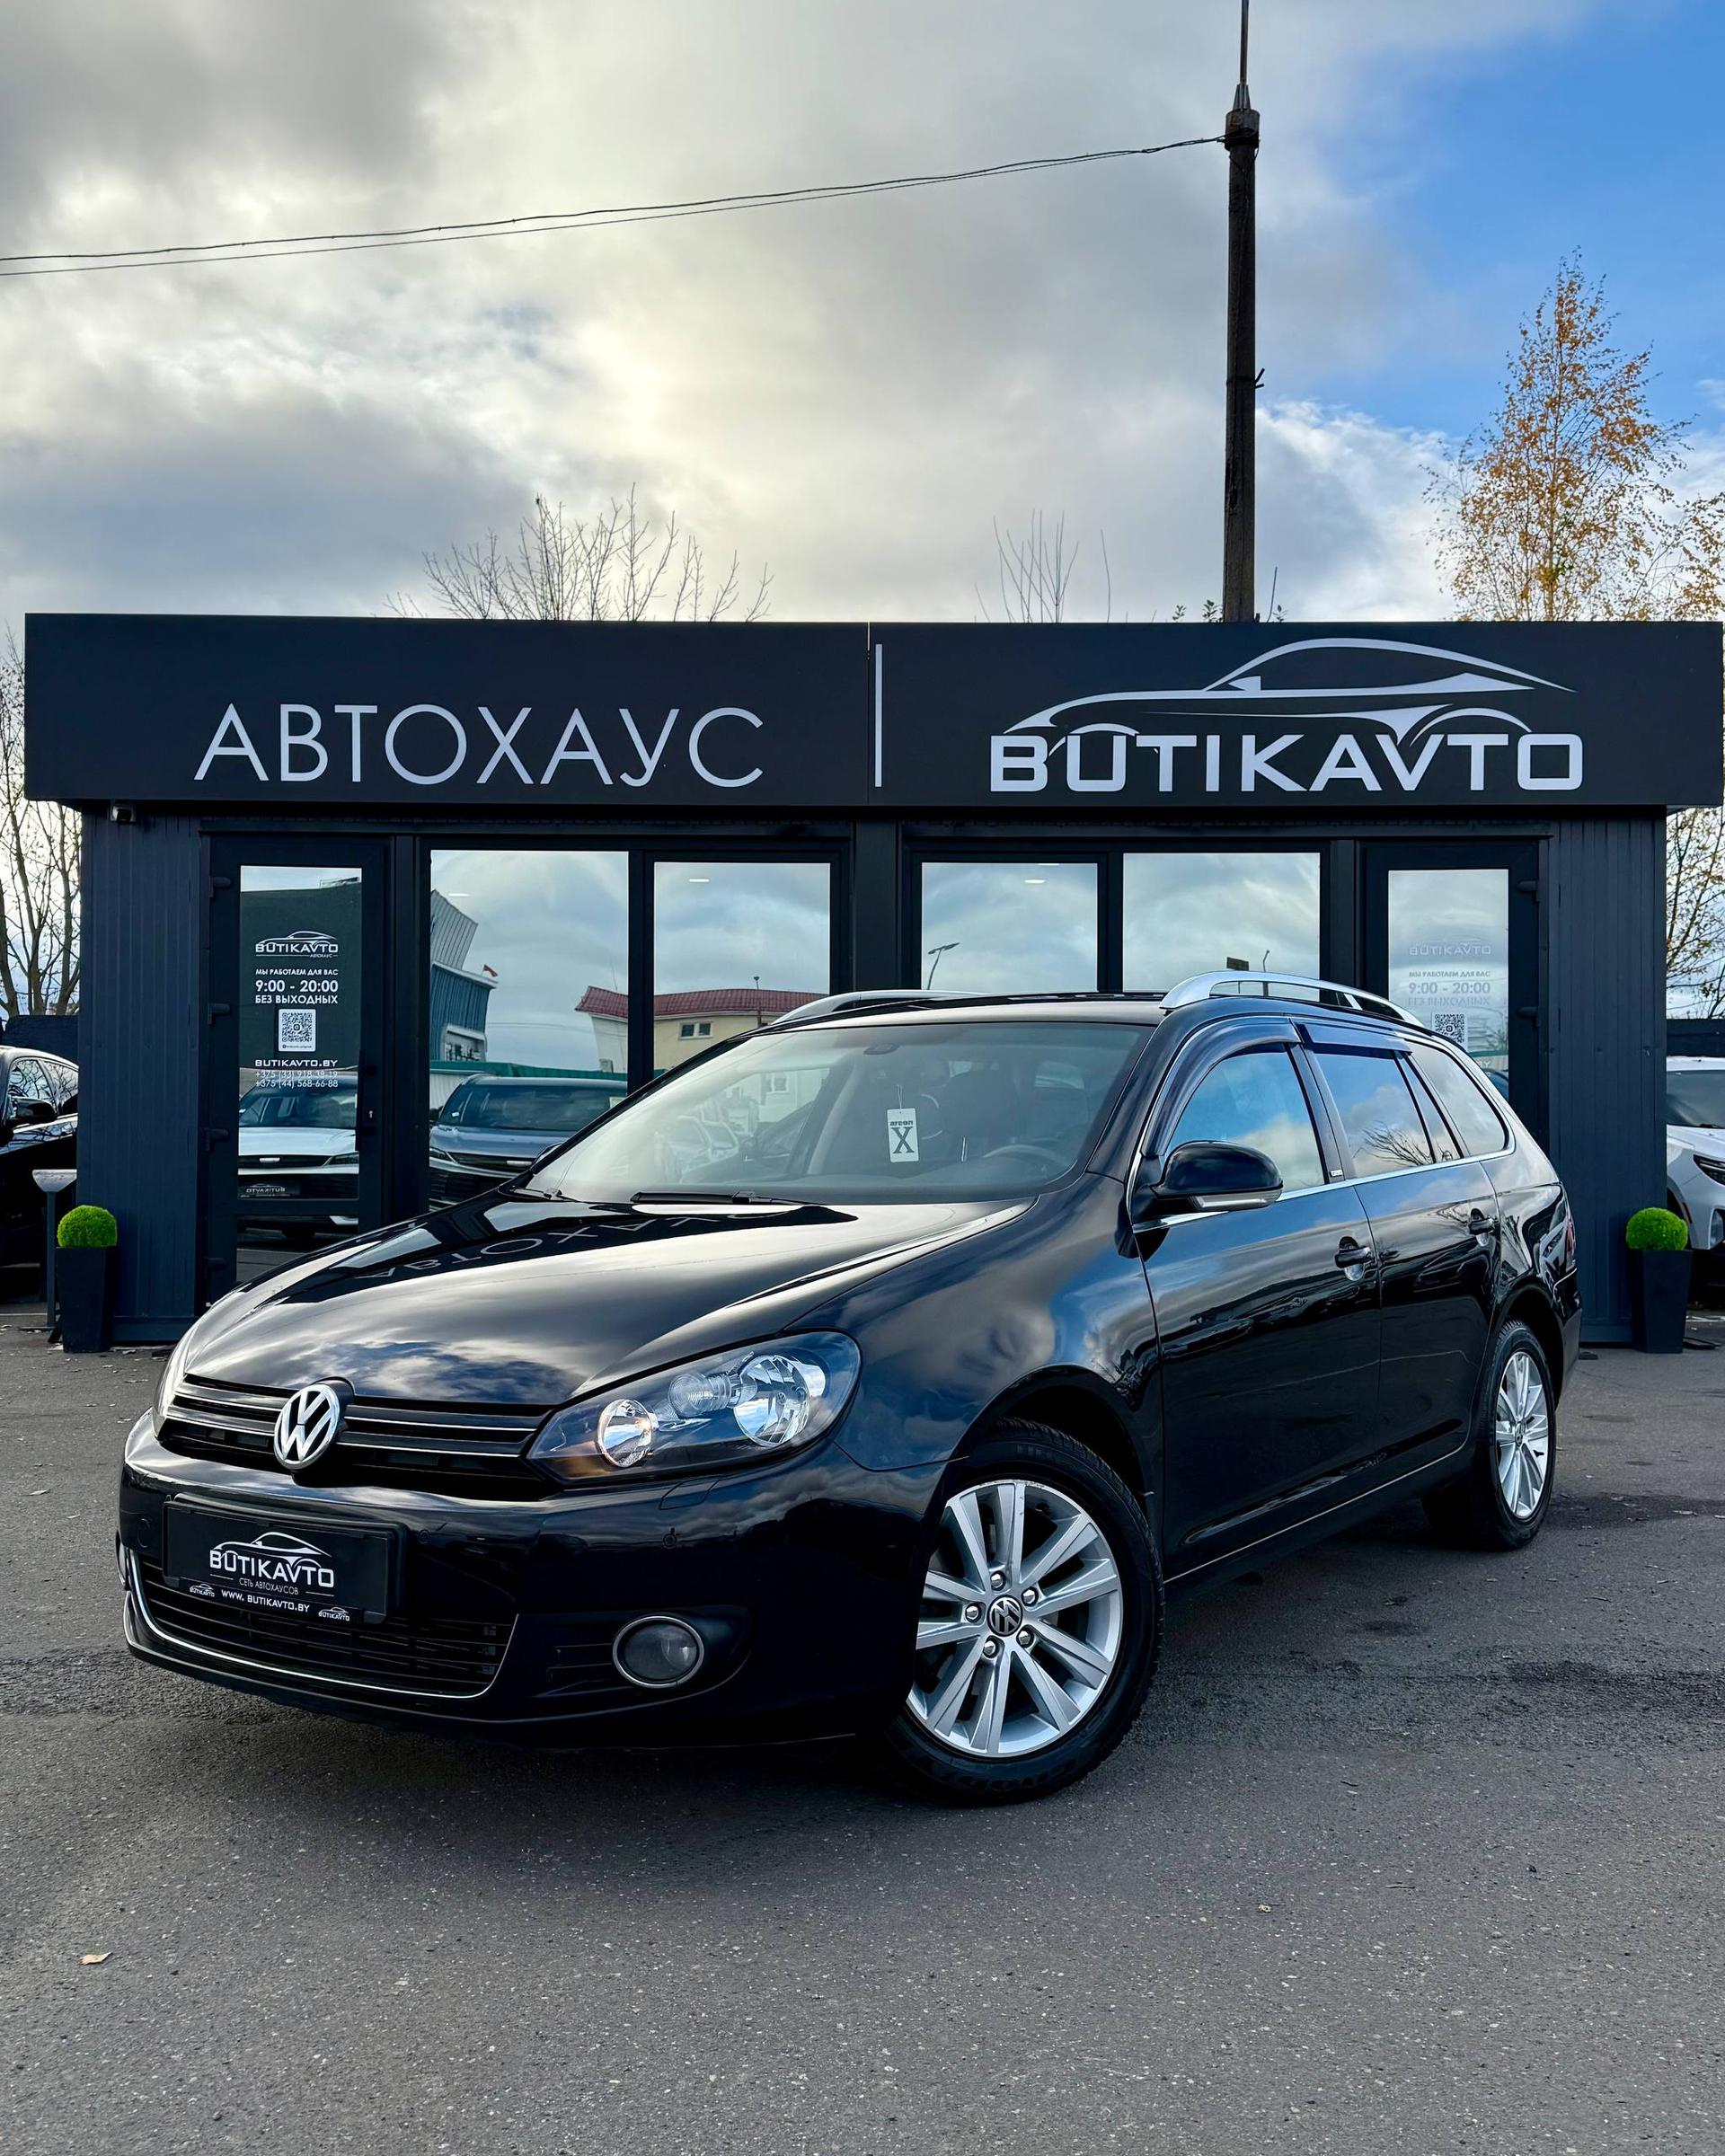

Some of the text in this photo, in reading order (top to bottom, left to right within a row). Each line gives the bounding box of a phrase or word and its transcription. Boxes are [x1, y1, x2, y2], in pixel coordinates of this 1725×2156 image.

[194, 702, 765, 788] АВТОХАУС
[990, 733, 1584, 792] BUTIKAVTO
[255, 943, 339, 953] BUTIKAVTO
[1409, 946, 1492, 956] BUTIKAVTO
[255, 979, 286, 992] 9:00
[299, 979, 339, 992] 20:00
[1409, 982, 1438, 994] 9:00
[1452, 982, 1491, 994] 20:00
[255, 994, 339, 1004] БЕЗ ВЫХОДНЫХ
[279, 1079, 295, 1089] (44)
[890, 1127, 916, 1153] X
[209, 1549, 334, 1588] BUTIKAVTO
[190, 1586, 215, 1597] BUTIKAVTO
[254, 1581, 299, 1595] АВТОХАУСОВ
[318, 1611, 350, 1621] BUTIKAVTO
